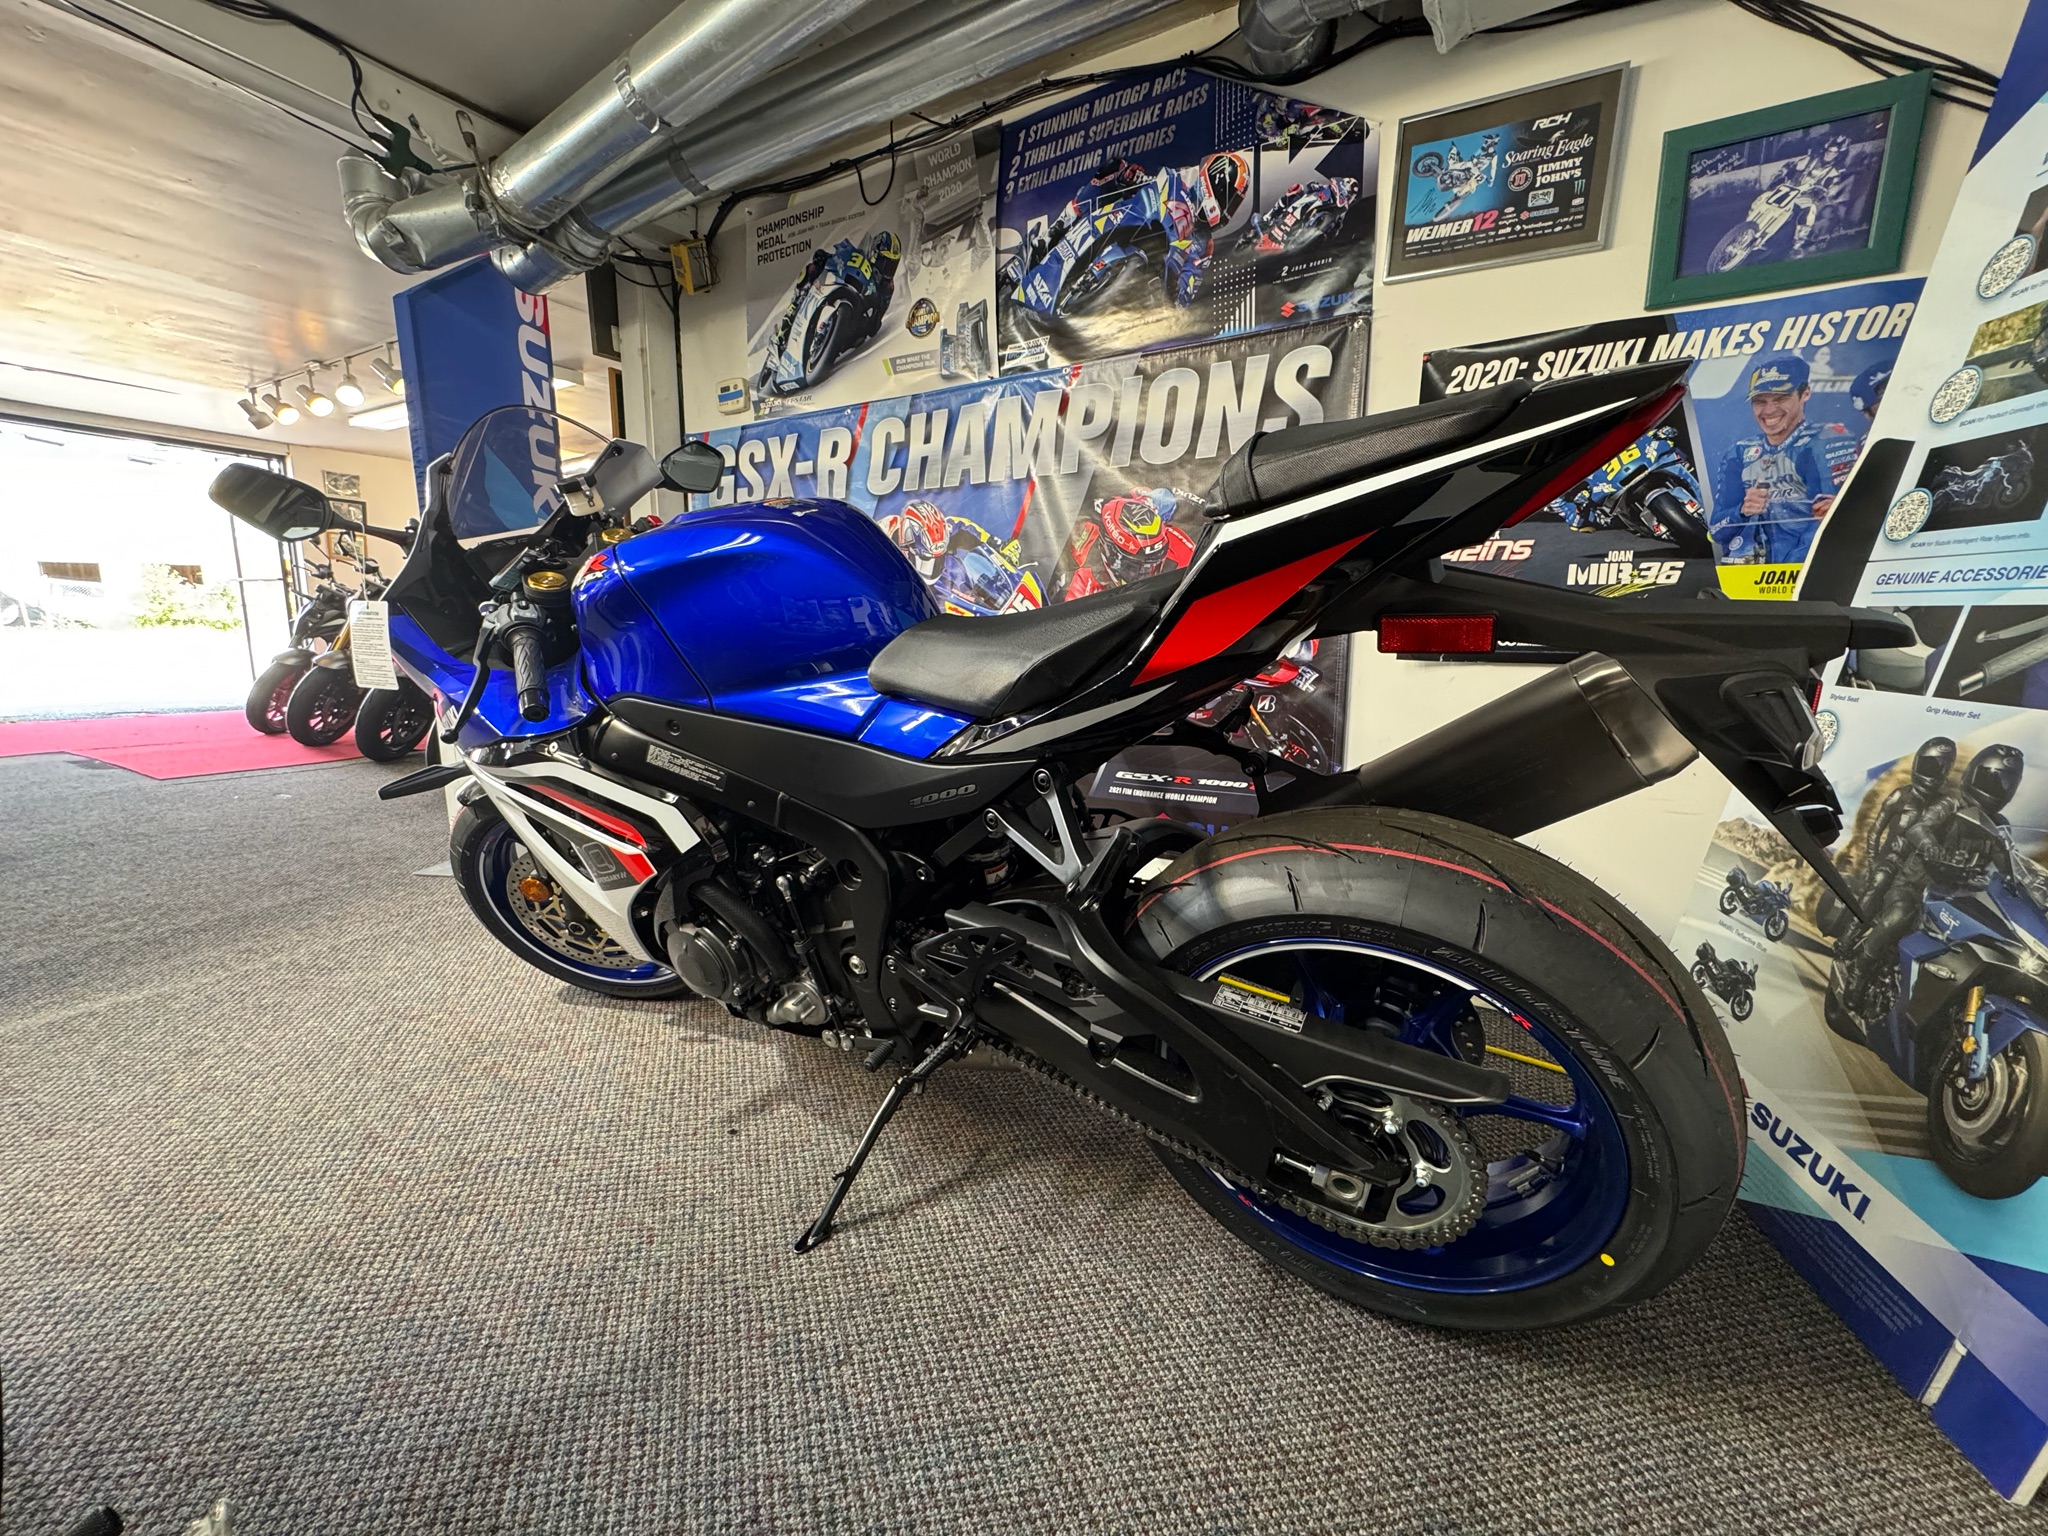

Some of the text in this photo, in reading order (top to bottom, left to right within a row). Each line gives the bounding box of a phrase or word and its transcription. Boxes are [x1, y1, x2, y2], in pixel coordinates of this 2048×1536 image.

[1017, 67, 1188, 152] 1 STUNNING MOTOGP RACE
[1009, 83, 1210, 179] 2 THRILLING SUPERBIKE RACES
[1532, 111, 1573, 132] RCH
[926, 142, 961, 167] WORLD
[1502, 133, 1594, 169] Soaring Eagle
[923, 157, 973, 188] CHAMPION
[1004, 124, 1177, 204] 3 EXHILARATING VICTORIES
[1536, 157, 1584, 177] JIMMY
[1535, 168, 1582, 188] JOHN'S
[938, 181, 963, 202] 2020
[756, 205, 825, 239] CHAMPIONSHIP
[1405, 218, 1474, 244] WEIMER
[1472, 209, 1499, 232] 12
[756, 234, 787, 253] MEDAL
[756, 238, 812, 267] PROTECTION
[1297, 289, 1356, 313] SZUK
[2009, 286, 2030, 298] SCAN
[1445, 356, 1530, 395] 2020:
[1532, 337, 1648, 383] SUZUKI
[1648, 320, 1772, 363] MAKES
[514, 287, 565, 527] SUZUK
[708, 343, 1334, 506] GSX-R CHAMPIONS
[1910, 541, 1926, 549] SCAN
[1604, 550, 1634, 563] JOAN
[1754, 569, 1801, 586] JOAN
[1875, 570, 1940, 587] GENUINE
[1758, 586, 1788, 595] WORLD
[1829, 693, 1860, 703] Styled Seat
[1925, 705, 1982, 720] Grip Heater Set
[1115, 770, 1192, 785] GSX-R
[909, 784, 976, 807] 1000
[1108, 785, 1218, 805] 2021 FIM ENDURANCE WORLD CHAMPION
[1750, 1101, 1872, 1222] SUZUKI
